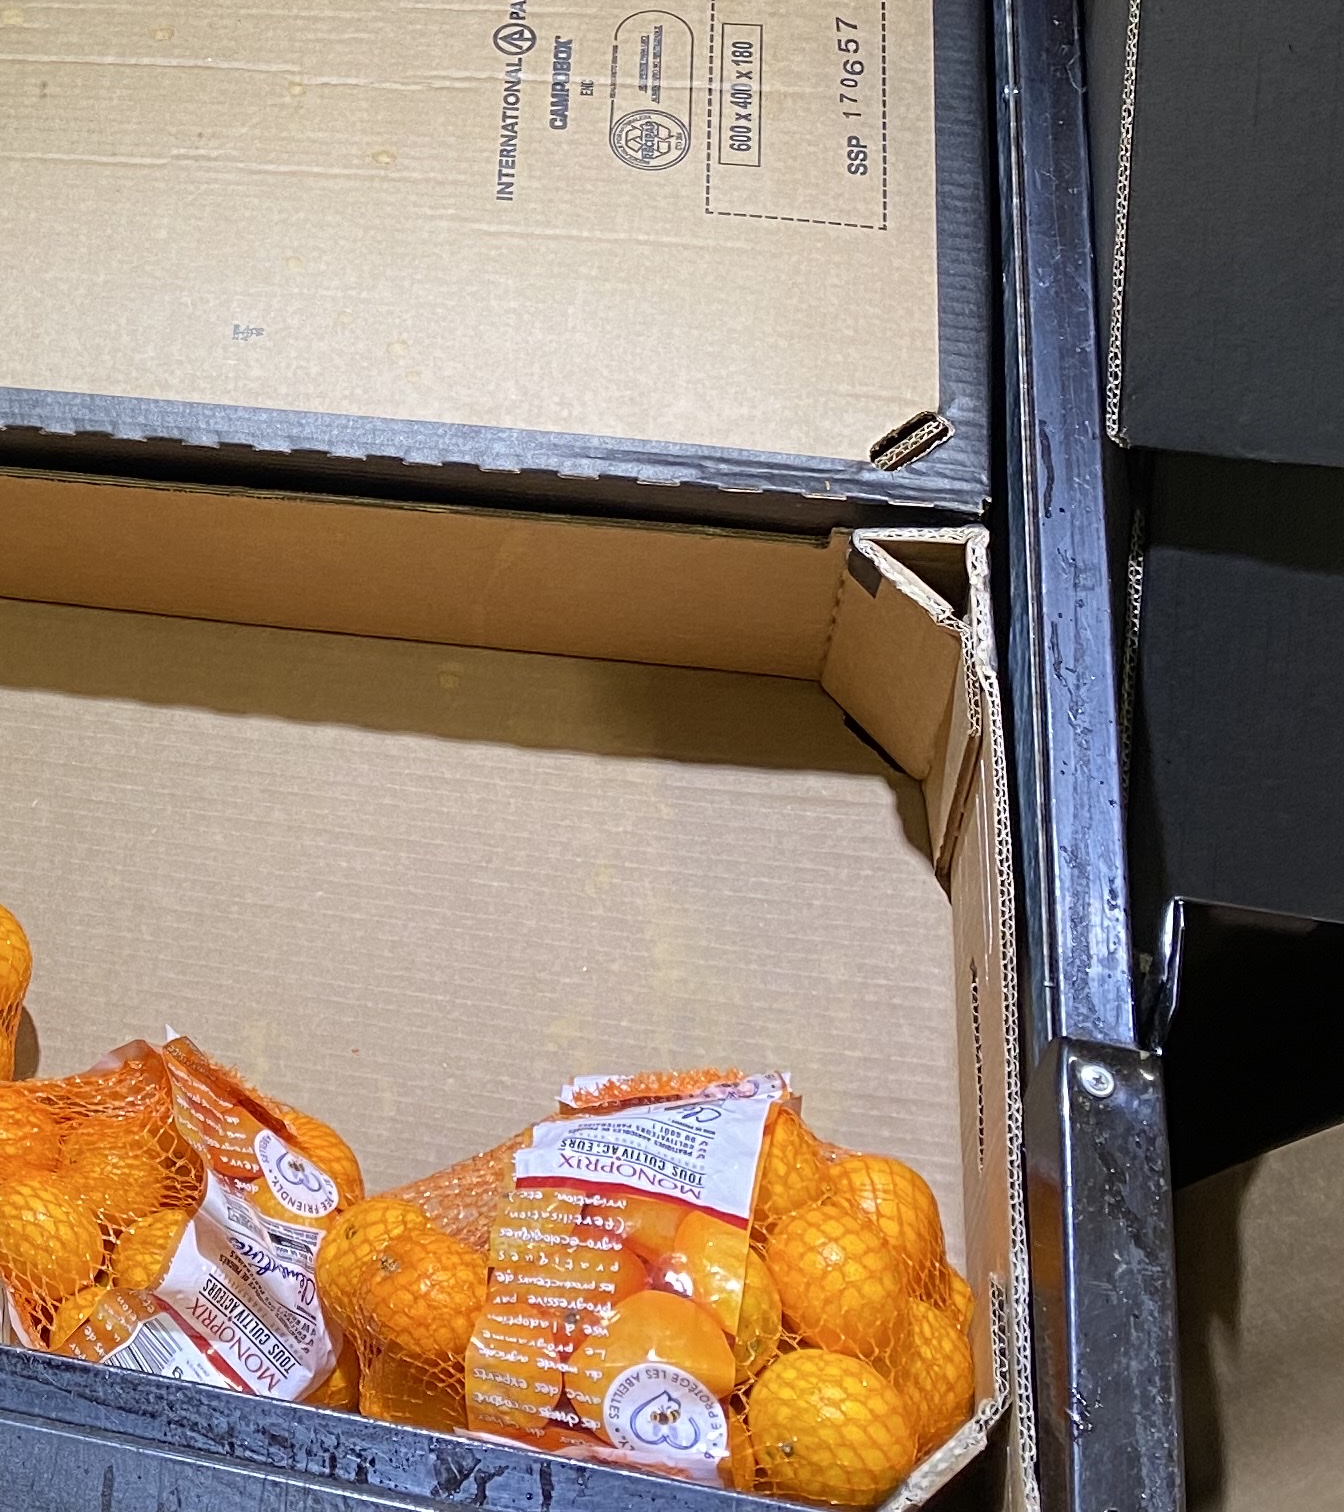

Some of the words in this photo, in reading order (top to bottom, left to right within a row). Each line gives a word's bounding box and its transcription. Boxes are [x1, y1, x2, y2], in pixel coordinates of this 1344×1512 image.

[731, 41, 753, 67] 180
[834, 16, 866, 119] 170657
[548, 35, 574, 130] CAMPOBOX
[730, 85, 752, 109] 400
[496, 57, 524, 202] INTERNATIONAL
[729, 126, 752, 152] 600
[847, 135, 869, 176] SSP
[559, 1152, 702, 1200] MONOPRIX
[671, 1167, 704, 1185] TOUS
[272, 1175, 319, 1214] FRIENDLY
[493, 1294, 517, 1305] par
[598, 1283, 616, 1294] les
[527, 1294, 613, 1318] progressive
[186, 1297, 281, 1393] MONOPRIX
[268, 1343, 297, 1375] TOUS
[646, 1369, 667, 1380] LES
[609, 1372, 640, 1419] ABEILLES
